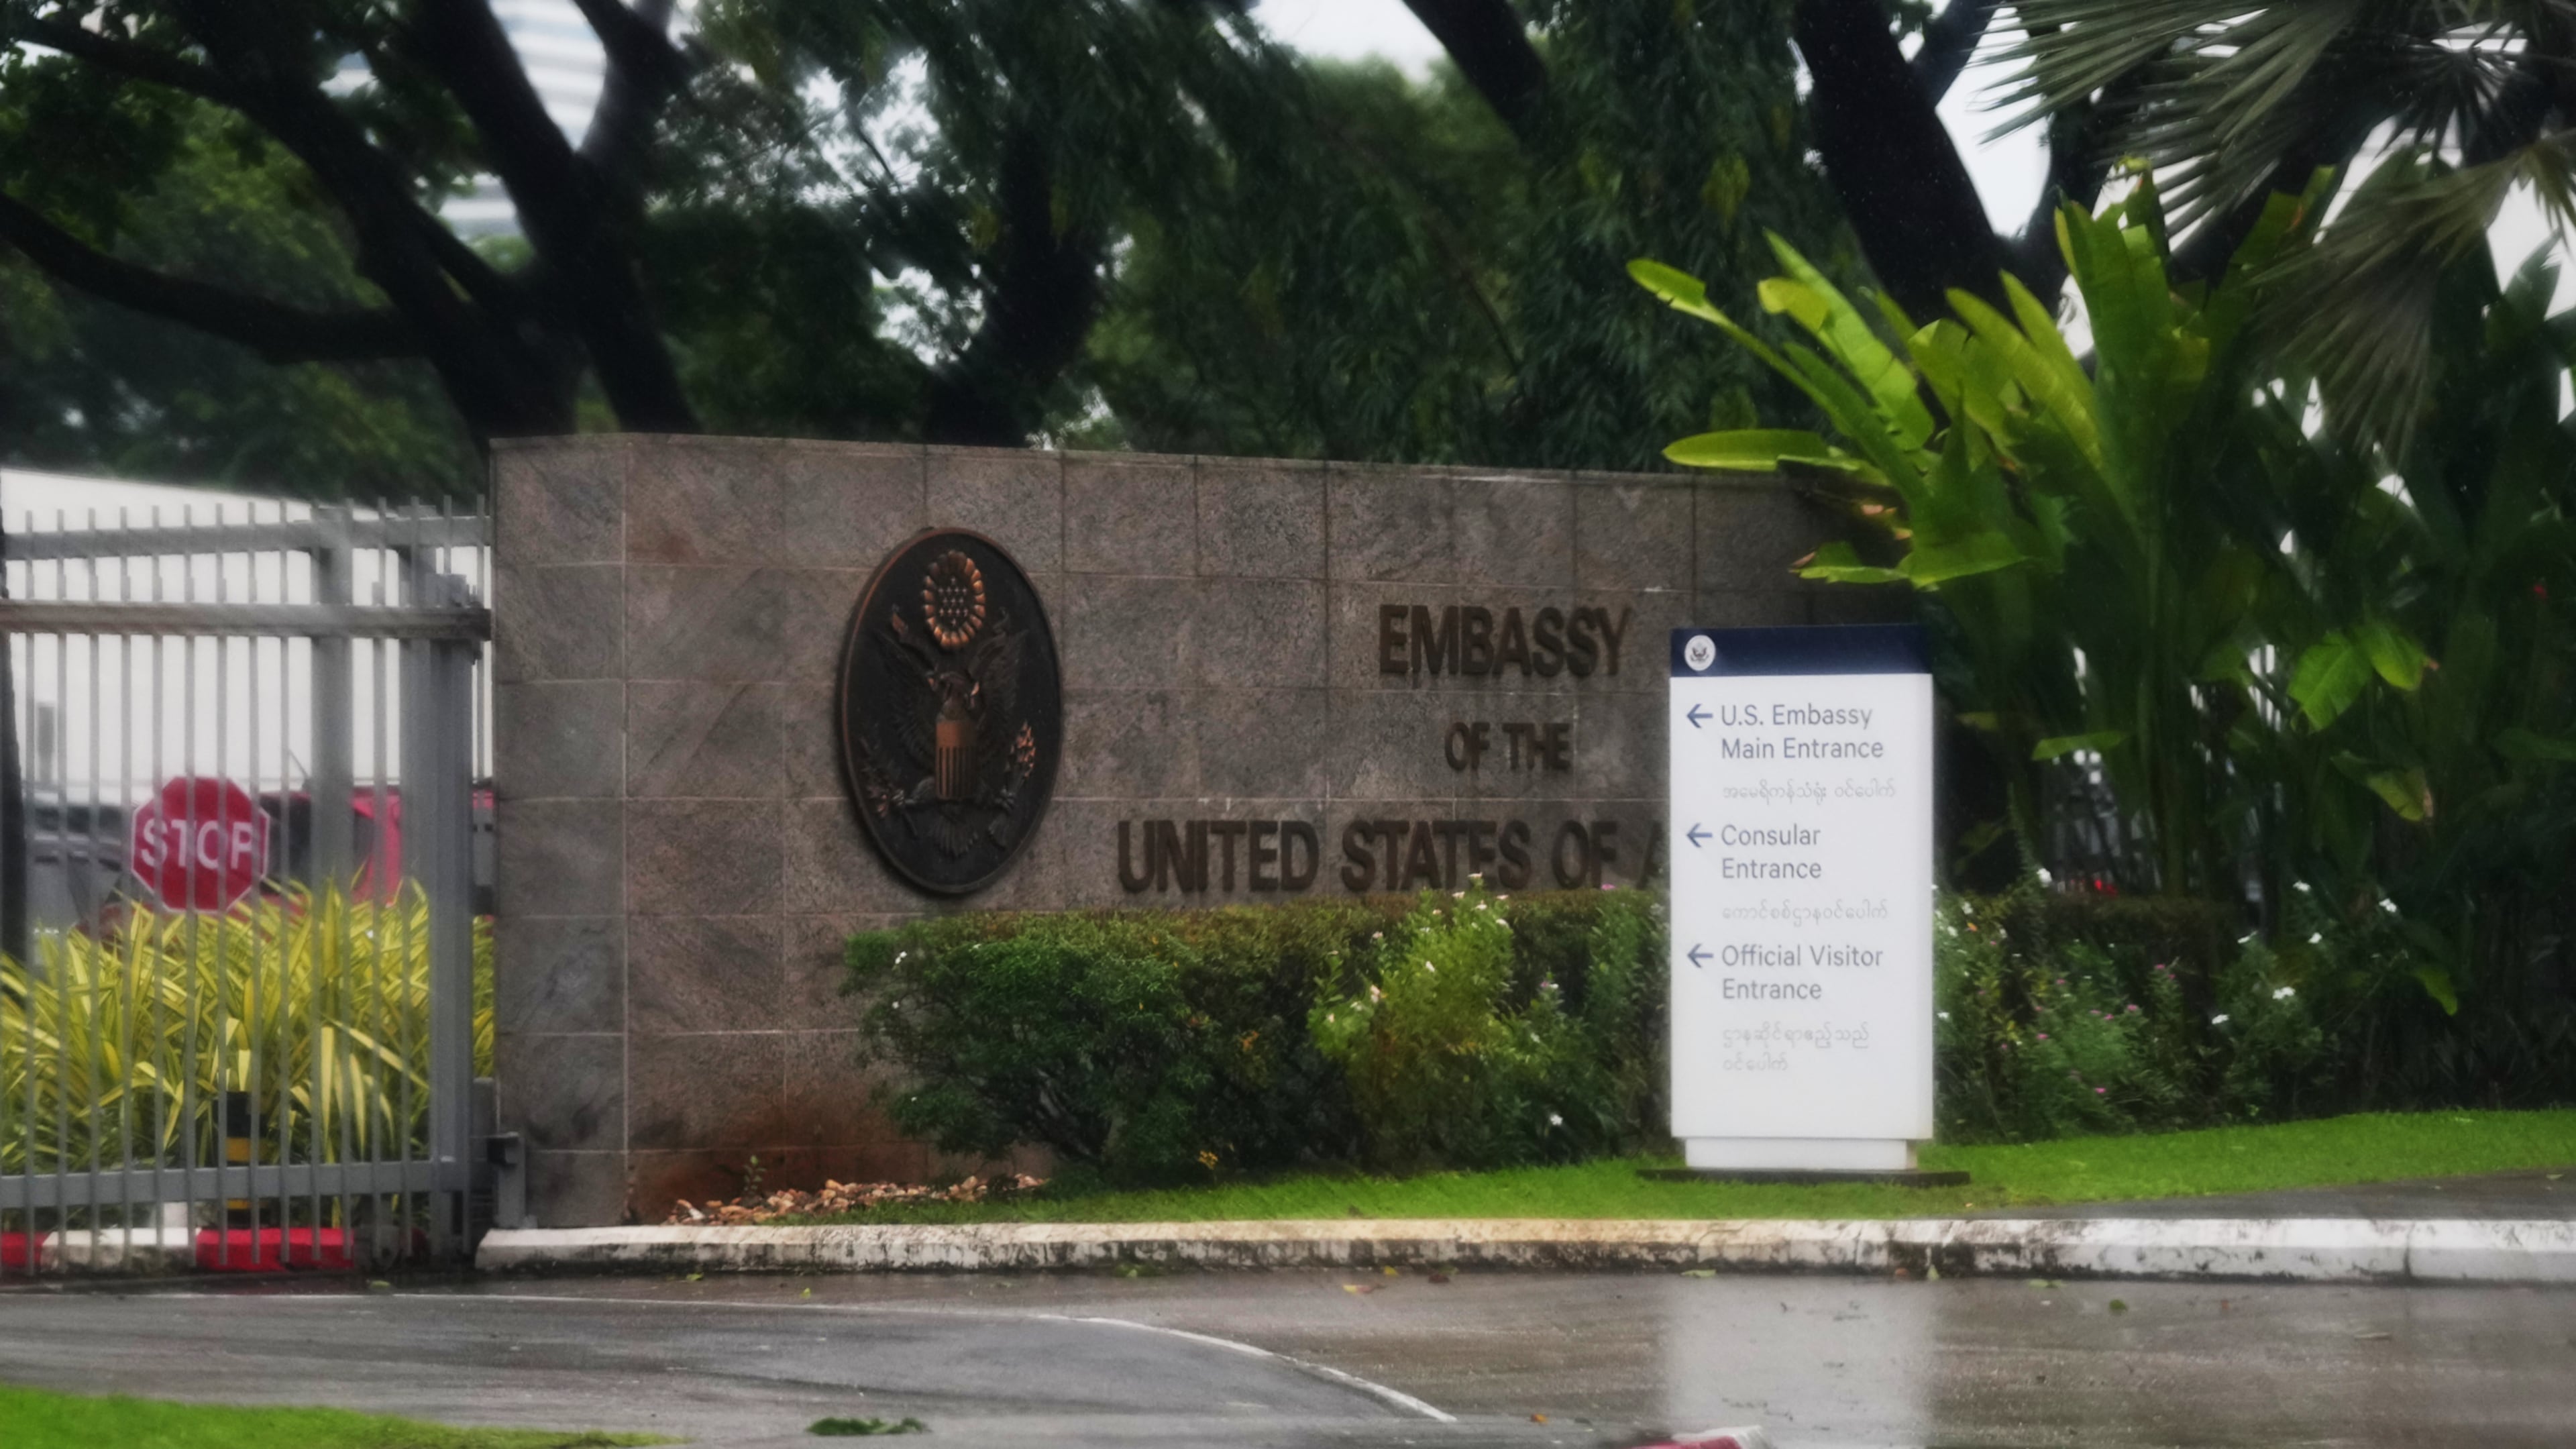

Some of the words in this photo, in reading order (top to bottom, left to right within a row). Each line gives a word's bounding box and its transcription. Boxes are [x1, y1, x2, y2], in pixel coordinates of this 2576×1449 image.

[1379, 604, 1631, 678] EMBASSY
[1722, 704, 1764, 726] U.S.
[1773, 703, 1872, 730] Embassy
[1444, 721, 1491, 771] OF
[1502, 722, 1571, 771] THE
[1722, 737, 1774, 759] Main
[1784, 737, 1884, 759] Entrance
[141, 818, 260, 870] STOP
[1721, 823, 1821, 845] Consular
[1118, 820, 1320, 894] UNITED
[1342, 820, 1532, 892] STATES
[1552, 820, 1617, 890] OF
[1723, 857, 1821, 879] Entrance
[1722, 944, 1801, 966] Official
[1809, 945, 1883, 967] Visitor
[1723, 978, 1822, 1000] Entrance
